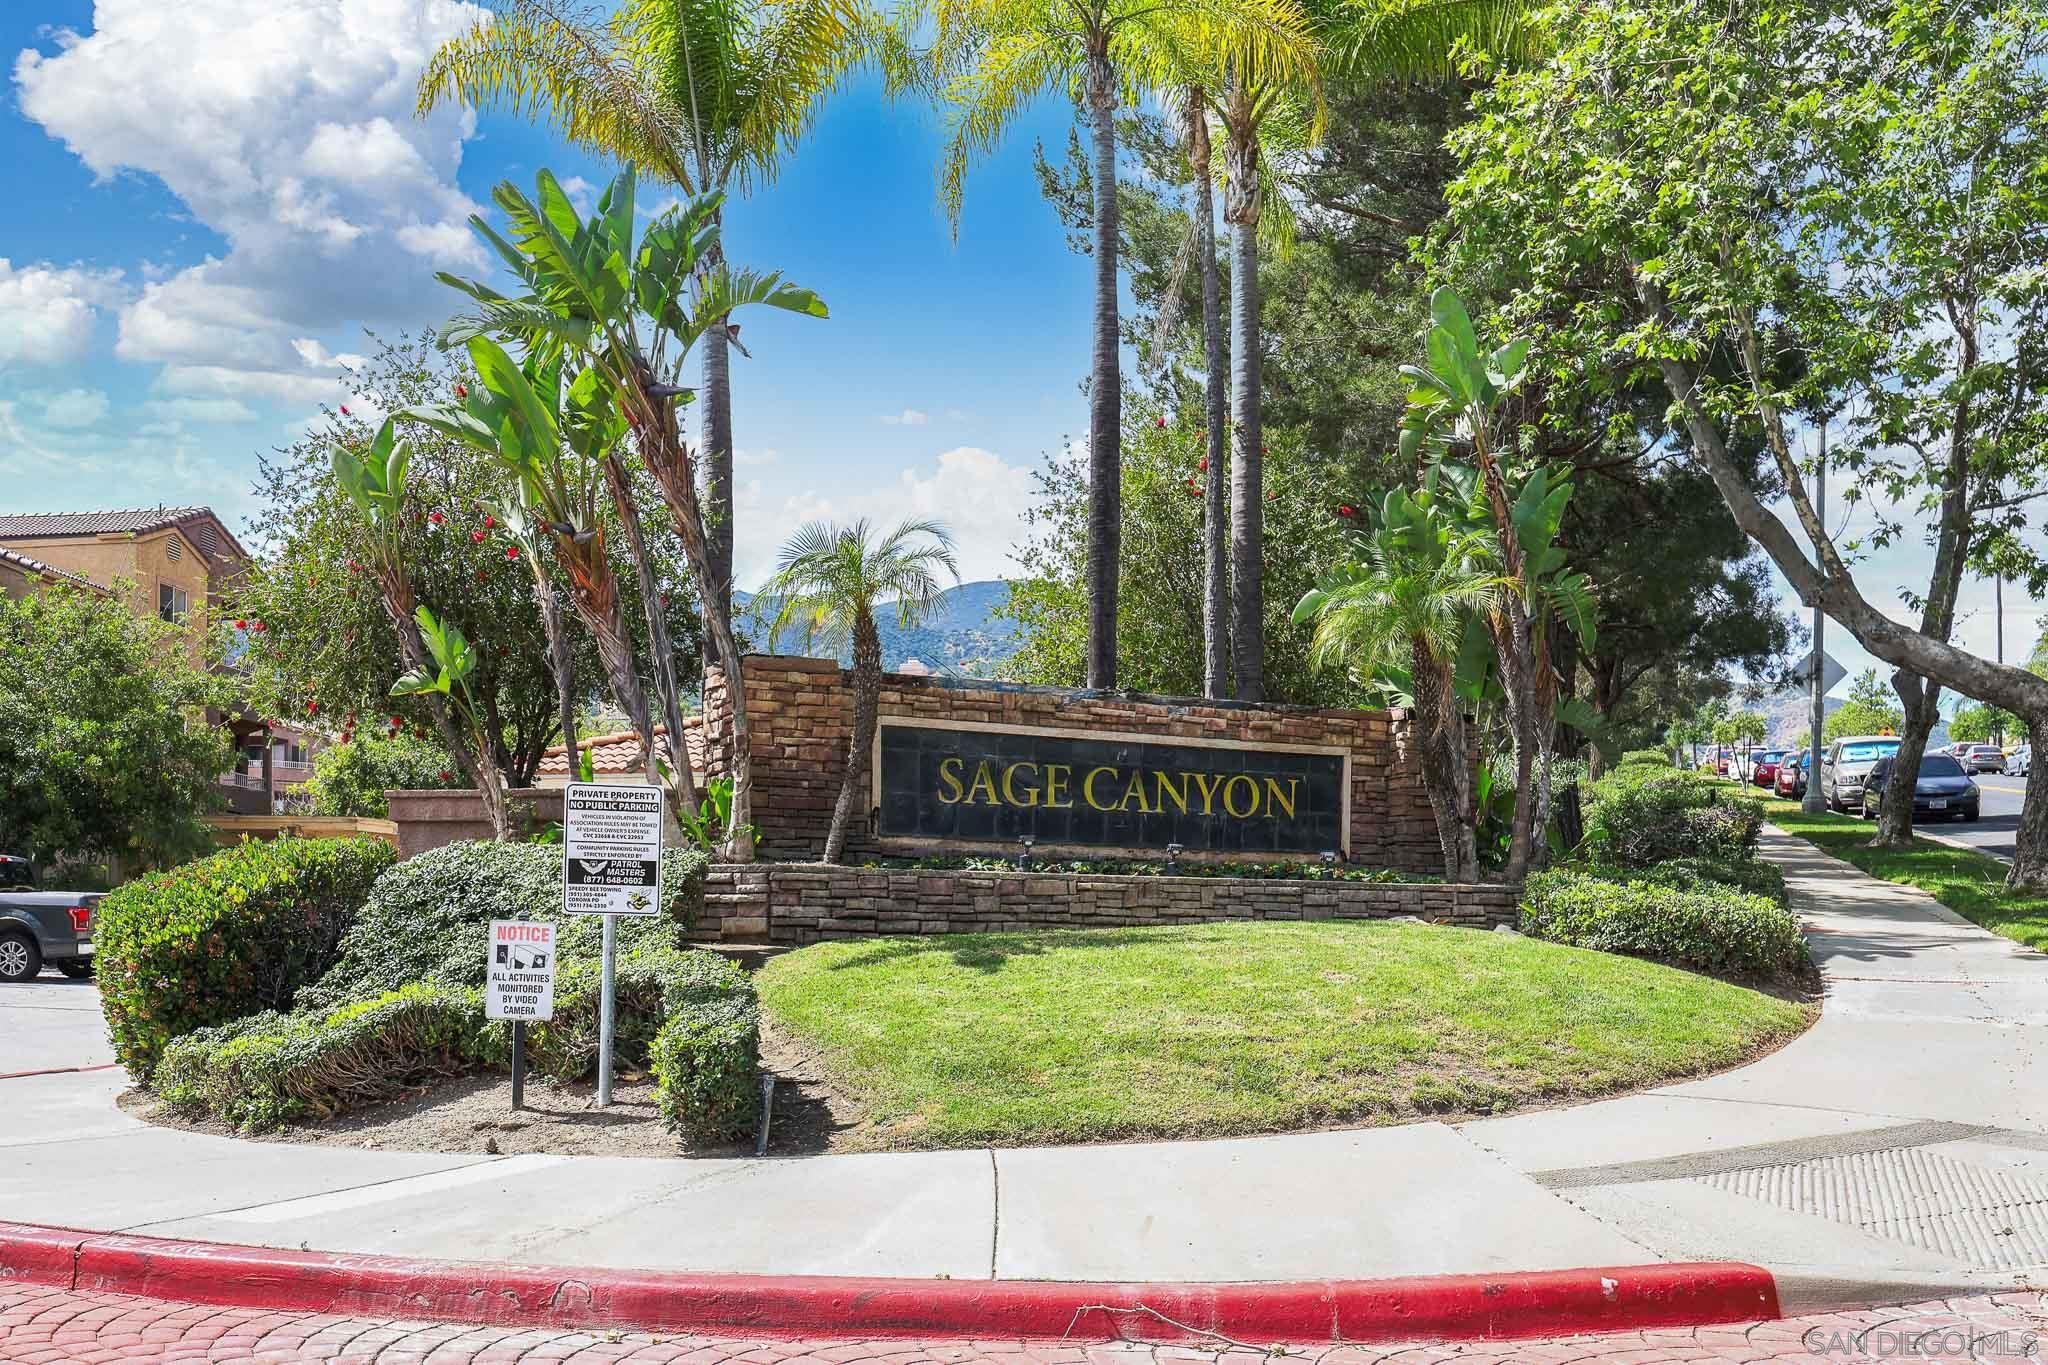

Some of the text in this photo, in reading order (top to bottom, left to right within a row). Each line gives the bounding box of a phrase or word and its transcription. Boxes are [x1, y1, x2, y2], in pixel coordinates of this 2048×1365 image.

[937, 758, 1298, 819] SAGE CANYON
[573, 790, 608, 798] PRIVATE
[497, 926, 550, 942] NOTICE
[493, 973, 550, 982] ALL ACTIVITIES
[498, 984, 543, 993] MONITORED
[503, 995, 537, 1004] BY VIDEO
[504, 1006, 535, 1014] CAMERA
